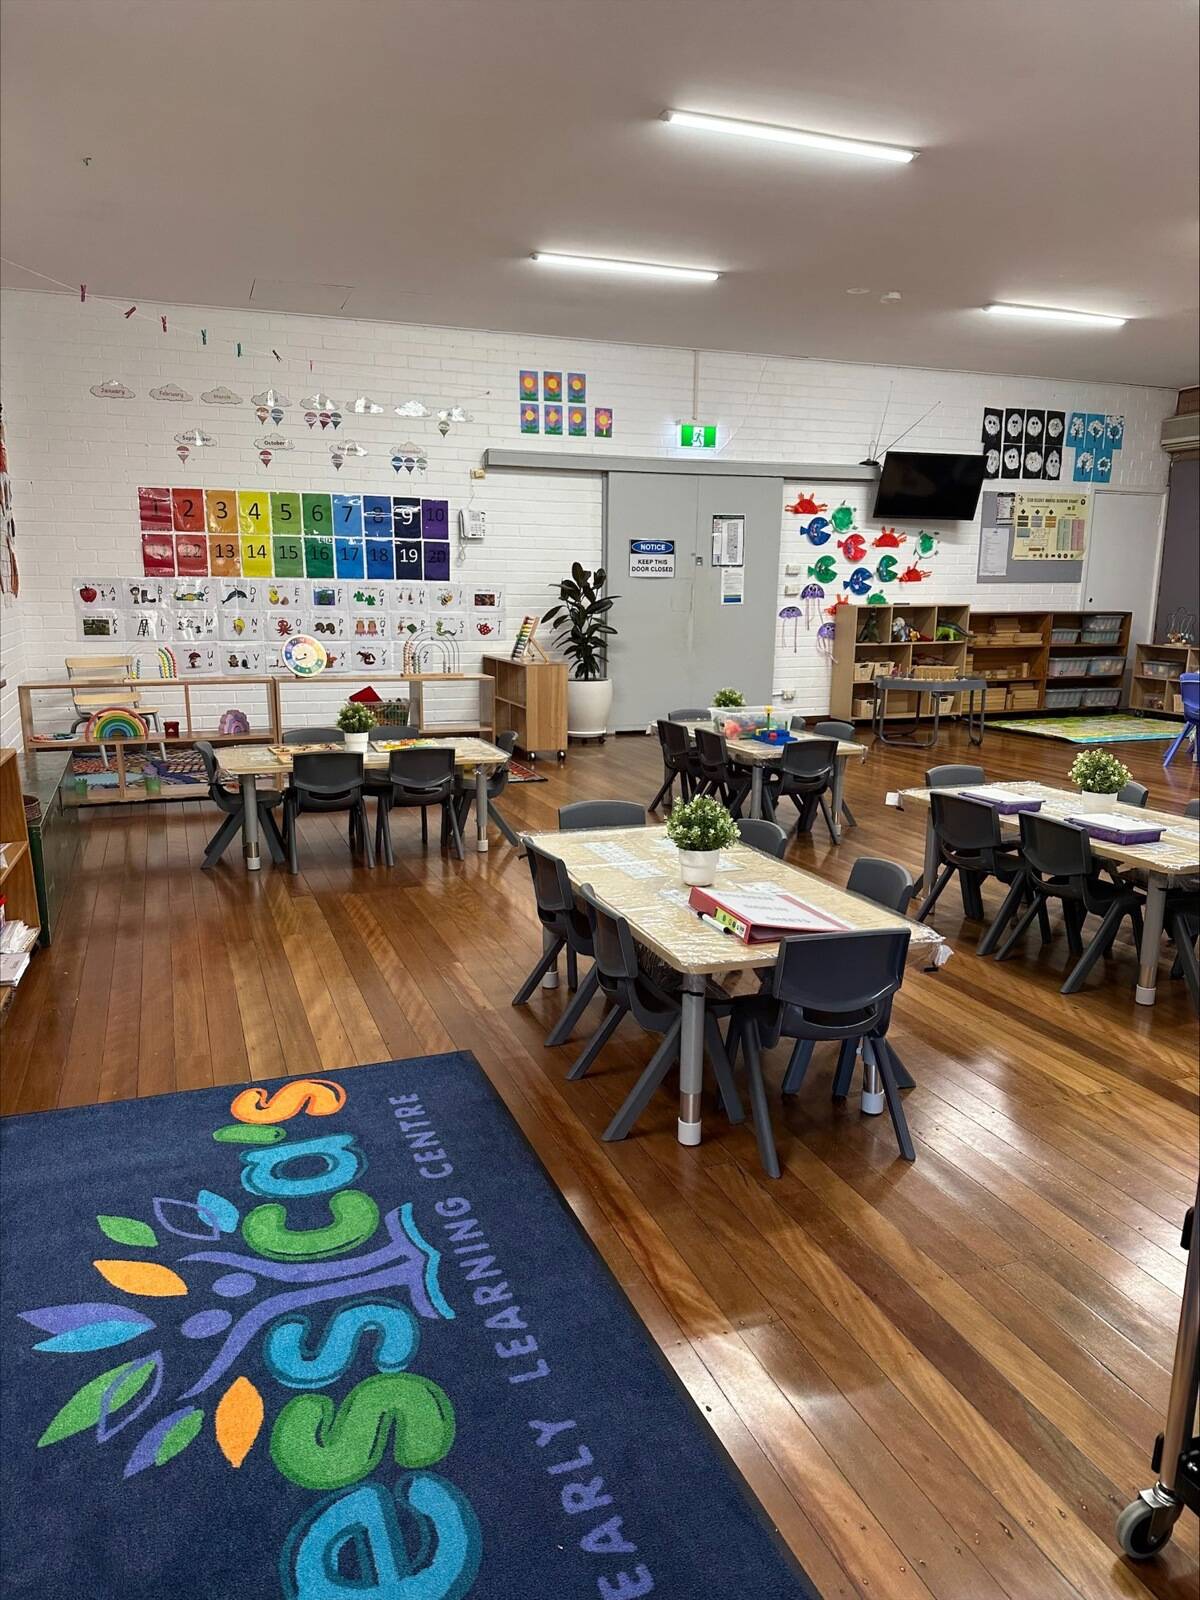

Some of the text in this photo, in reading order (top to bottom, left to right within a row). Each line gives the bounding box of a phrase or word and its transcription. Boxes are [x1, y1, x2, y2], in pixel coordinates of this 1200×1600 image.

[100, 388, 125, 396] January
[159, 390, 184, 399] February
[183, 499, 196, 518] 2
[215, 501, 228, 519] 3
[248, 502, 262, 520] 4
[280, 503, 293, 521] 5
[311, 504, 323, 522] 6
[341, 505, 353, 523] 7
[372, 506, 384, 524] 8
[401, 508, 413, 525] 9
[427, 507, 445, 522] 10
[215, 543, 236, 559] 13
[247, 544, 267, 559] 14
[279, 545, 298, 560] 15
[311, 545, 329, 561] 16
[341, 546, 359, 561] 17
[371, 547, 389, 562] 18
[640, 543, 666, 551] NOTICE
[400, 548, 418, 563] 19
[429, 550, 446, 563] 20
[388, 1093, 655, 1600] EARLY LEARNING CENTRE
